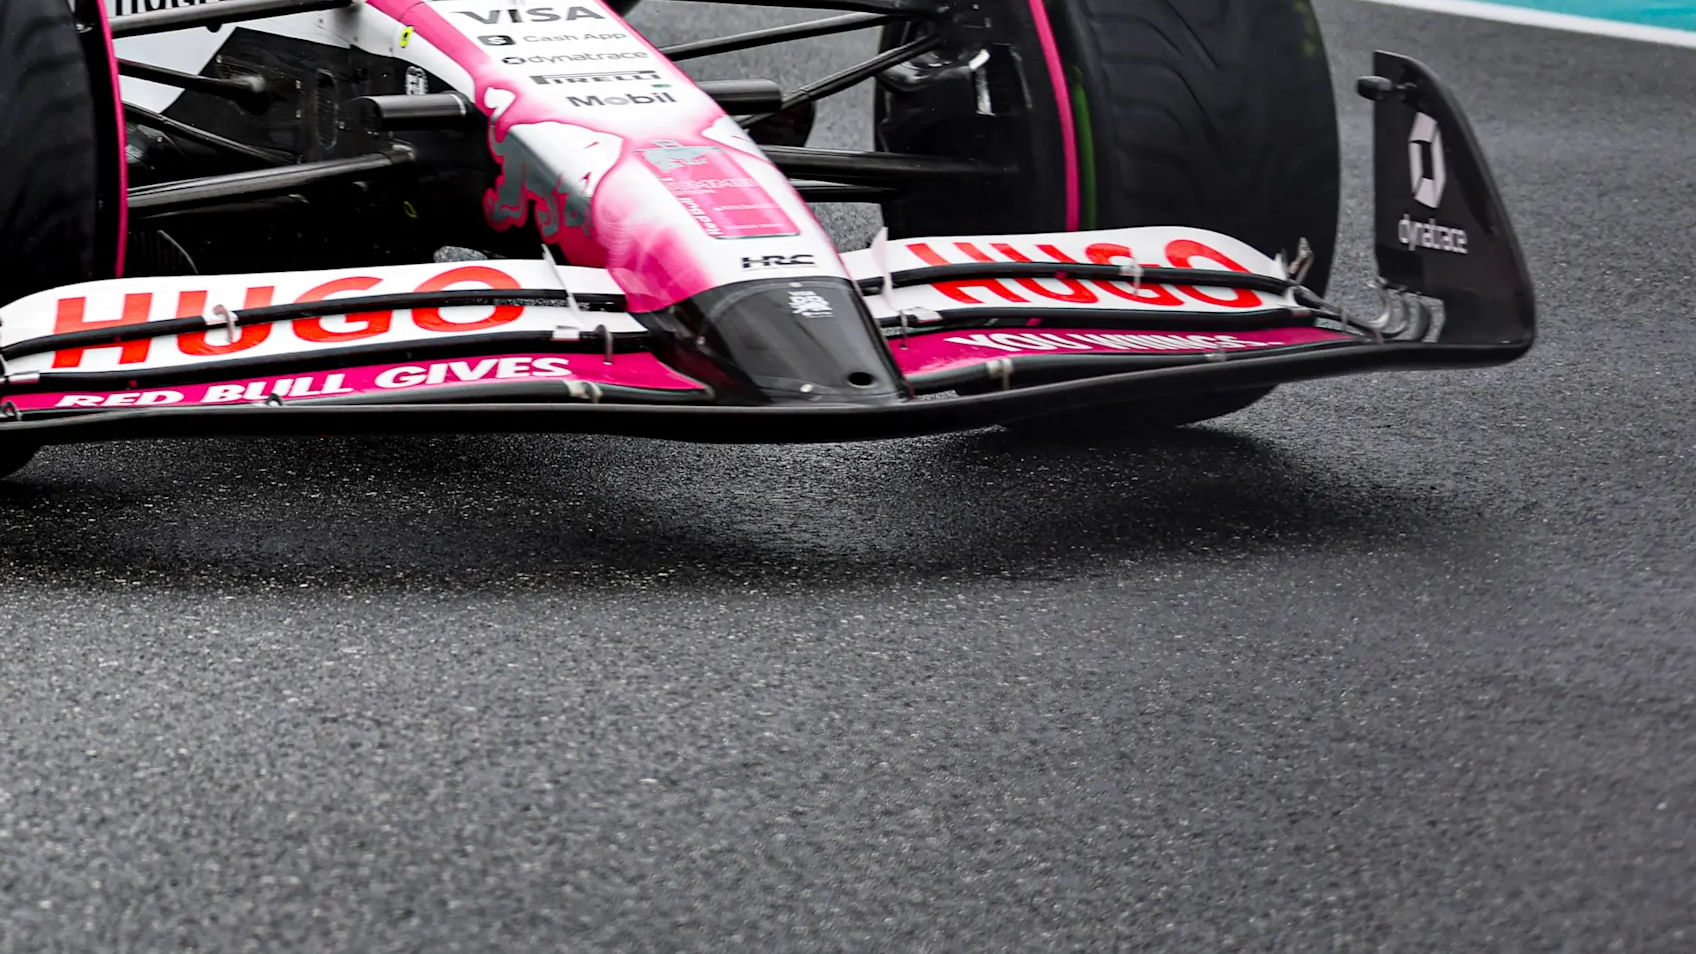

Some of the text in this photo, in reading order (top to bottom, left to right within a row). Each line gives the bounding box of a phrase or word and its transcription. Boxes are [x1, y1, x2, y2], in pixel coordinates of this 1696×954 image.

[450, 6, 605, 25] VISA
[522, 30, 627, 43] Cash App
[527, 49, 650, 64] dynatrace
[529, 69, 662, 85] PIRELLI
[566, 92, 677, 107] Mobil
[1398, 213, 1469, 255] dynatrace
[741, 254, 815, 269] HRC
[905, 239, 1264, 308] HUGO
[51, 265, 526, 369] HUGO
[944, 333, 1094, 352] YOU
[54, 356, 573, 407] RED BULL GIVES
